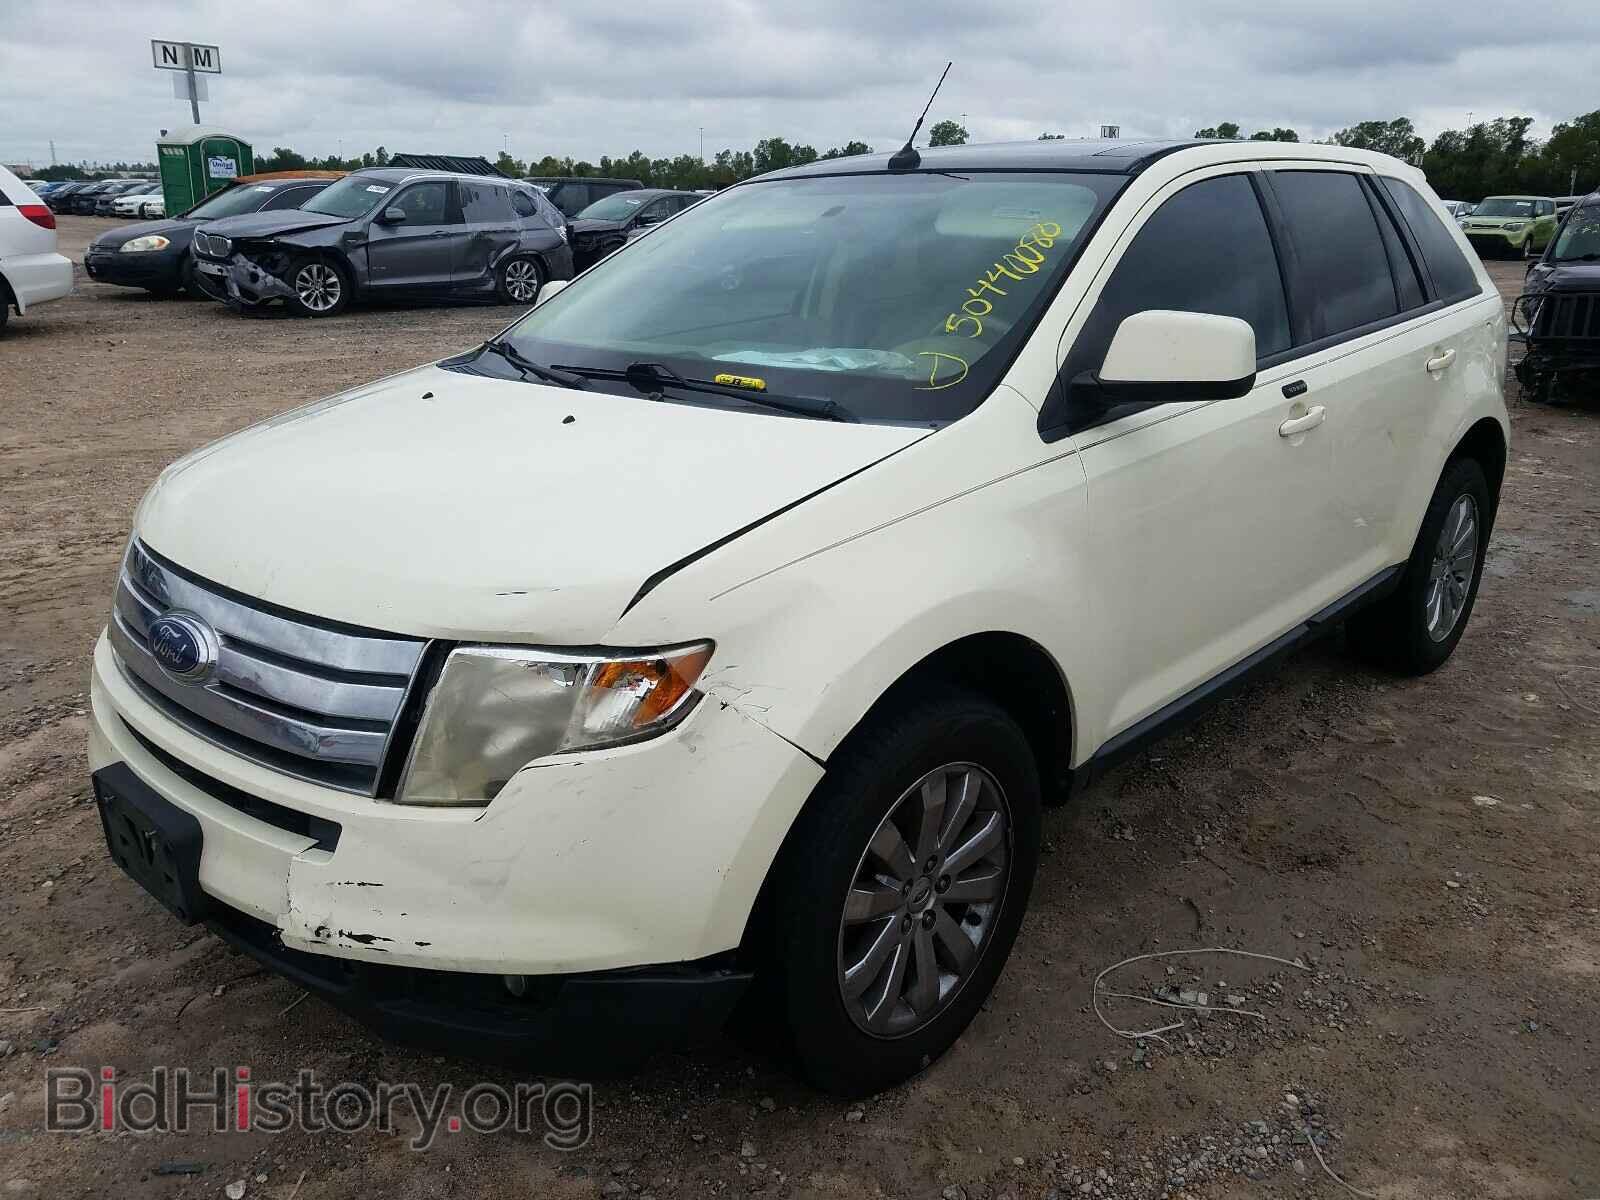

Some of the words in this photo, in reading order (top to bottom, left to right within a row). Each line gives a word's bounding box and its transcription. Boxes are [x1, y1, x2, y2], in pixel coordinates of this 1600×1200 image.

[162, 45, 178, 65] N
[194, 48, 212, 67] M
[153, 624, 187, 664] Ford
